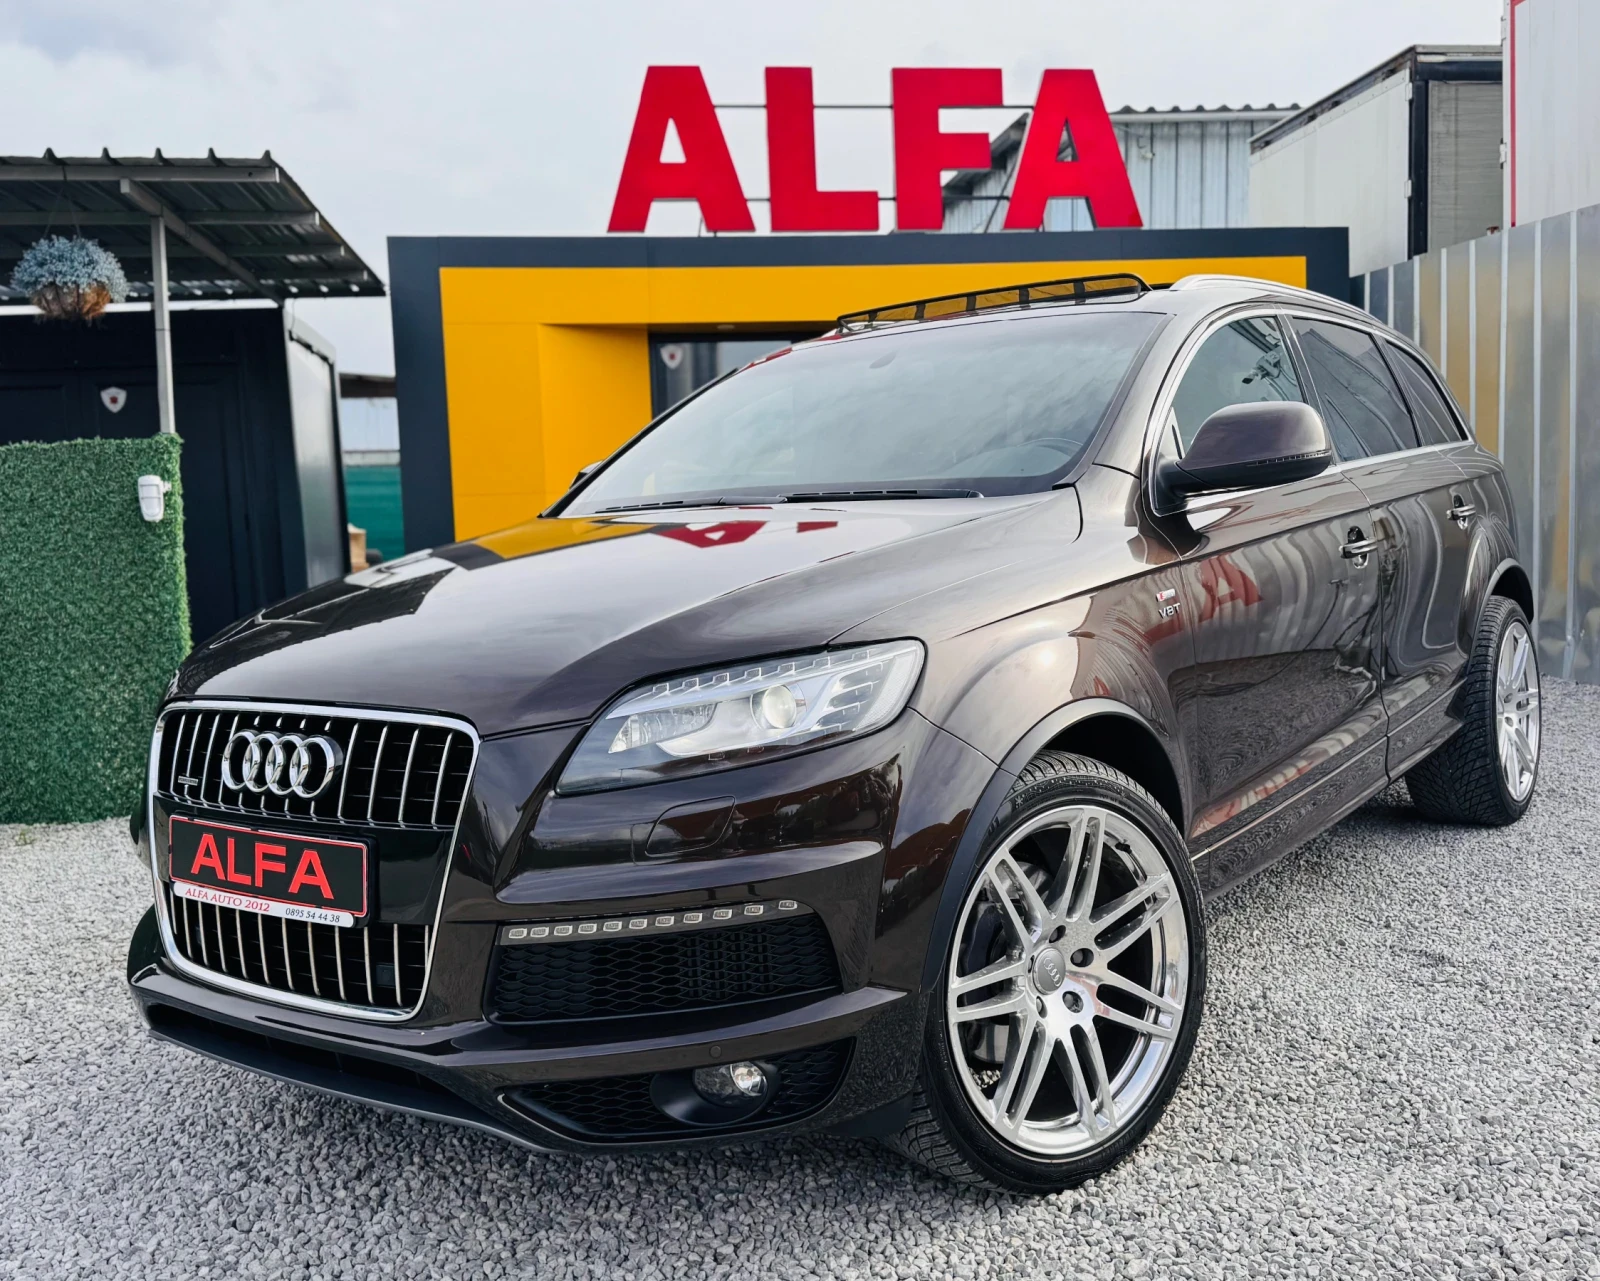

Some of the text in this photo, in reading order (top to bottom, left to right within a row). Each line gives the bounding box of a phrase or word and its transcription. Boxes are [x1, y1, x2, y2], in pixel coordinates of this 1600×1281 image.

[607, 65, 1144, 232] ALFA
[191, 833, 335, 899] ALFA
[185, 887, 271, 912] ALFA AUTO 2012
[285, 907, 341, 923] 0895 54 44 38
